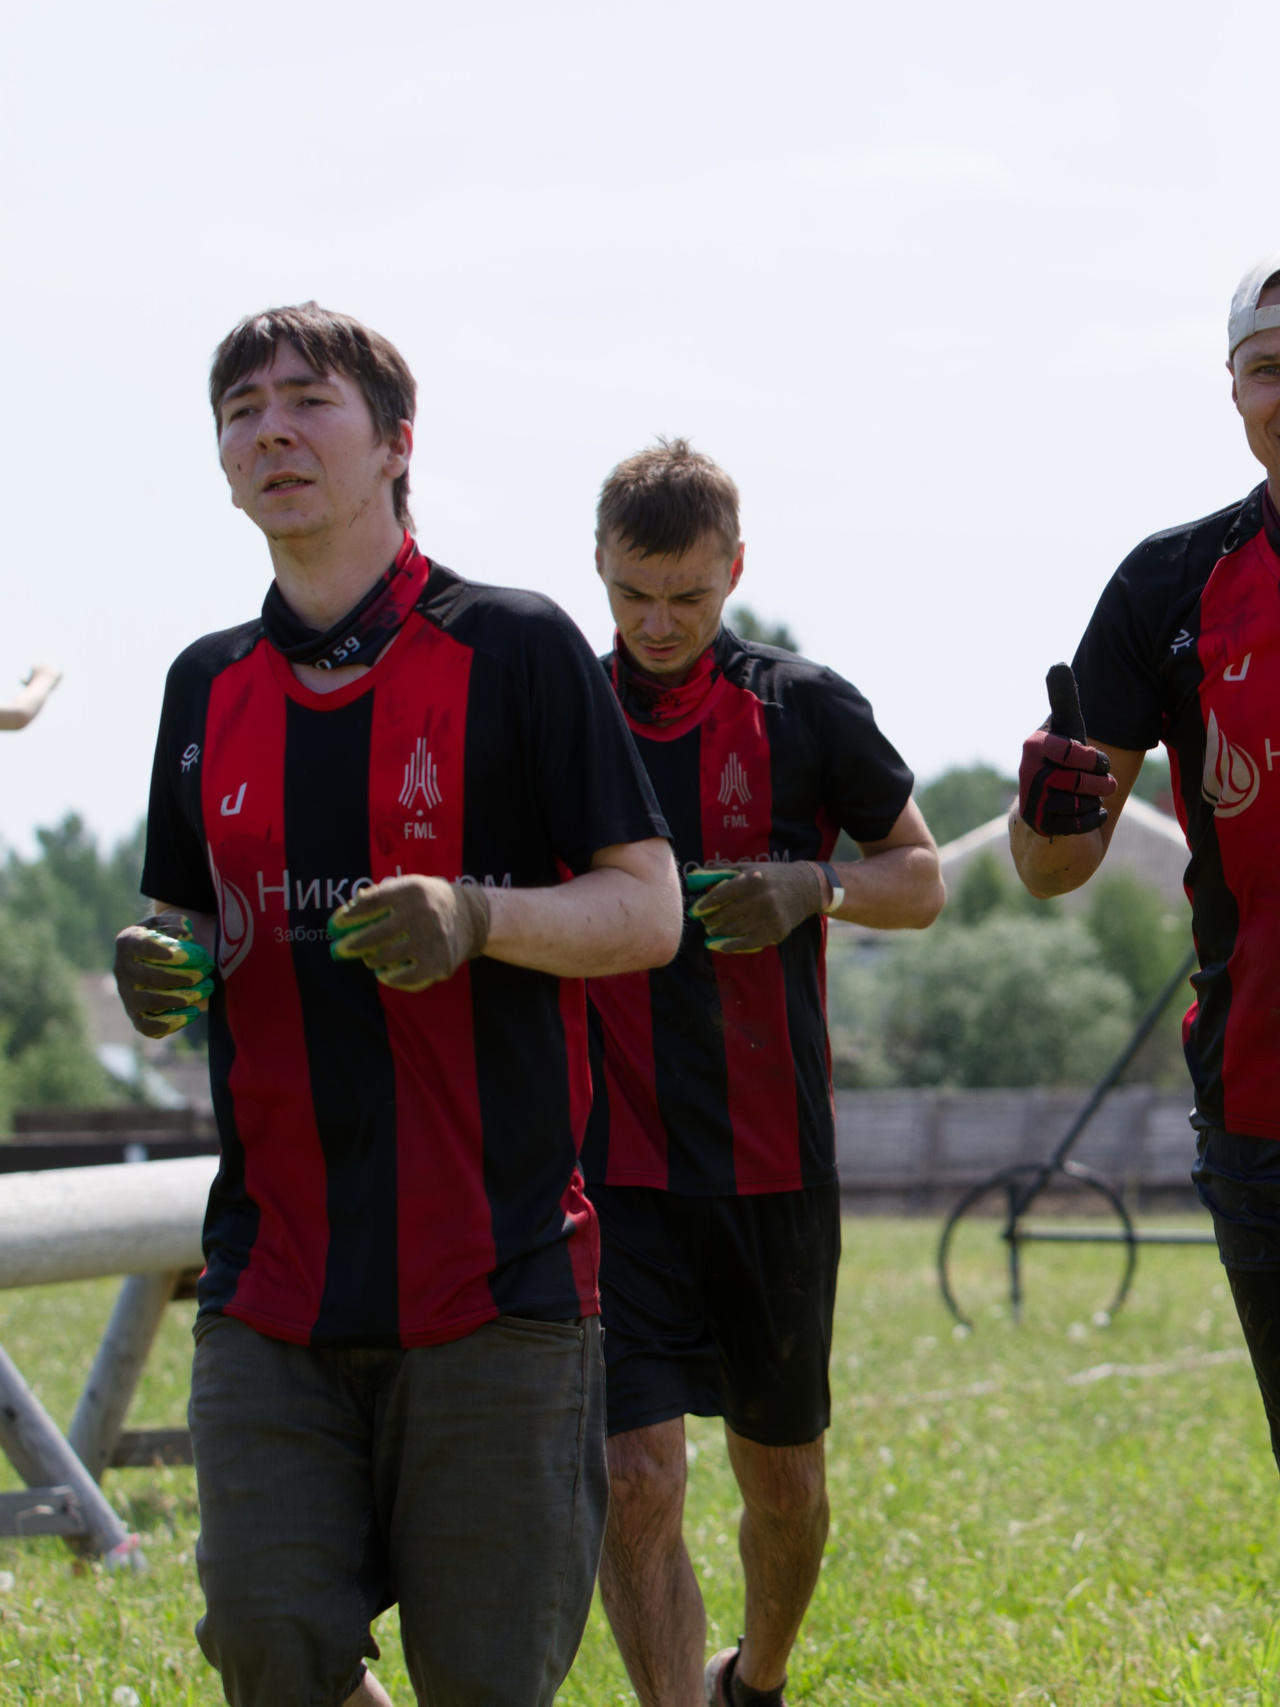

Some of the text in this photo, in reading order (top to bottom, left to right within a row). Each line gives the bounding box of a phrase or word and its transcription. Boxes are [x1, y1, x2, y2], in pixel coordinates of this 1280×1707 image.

[332, 636, 361, 661] 59
[723, 814, 750, 829] FML
[404, 822, 437, 840] FML
